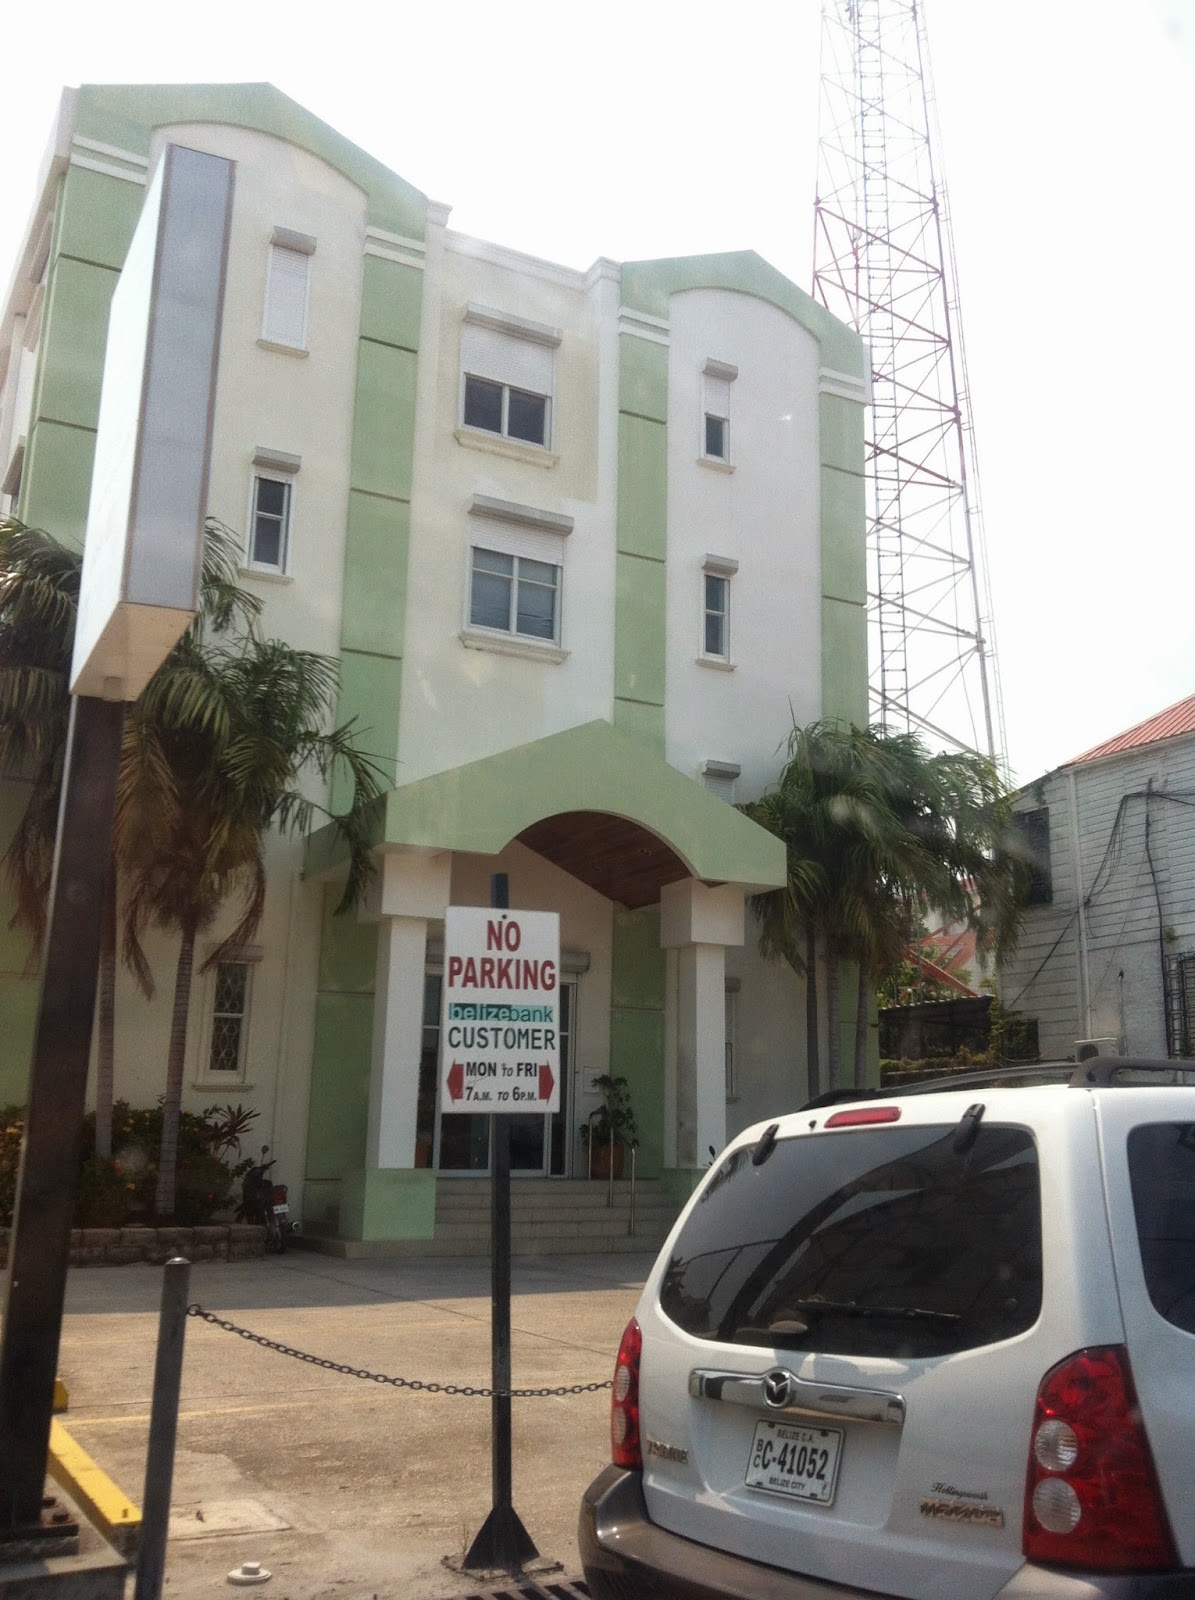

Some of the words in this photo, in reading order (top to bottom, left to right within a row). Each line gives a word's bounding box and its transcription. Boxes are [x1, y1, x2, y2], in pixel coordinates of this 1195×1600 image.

[487, 920, 521, 952] NO
[448, 956, 556, 991] PARKING
[448, 1027, 555, 1050] CUSTOMER
[466, 1062, 497, 1077] MON
[516, 1062, 538, 1077] FRI
[498, 1092, 510, 1101] TO
[777, 1429, 800, 1441] BELIZE
[769, 1477, 791, 1488] BELIZE
[791, 1480, 806, 1491] CITY
